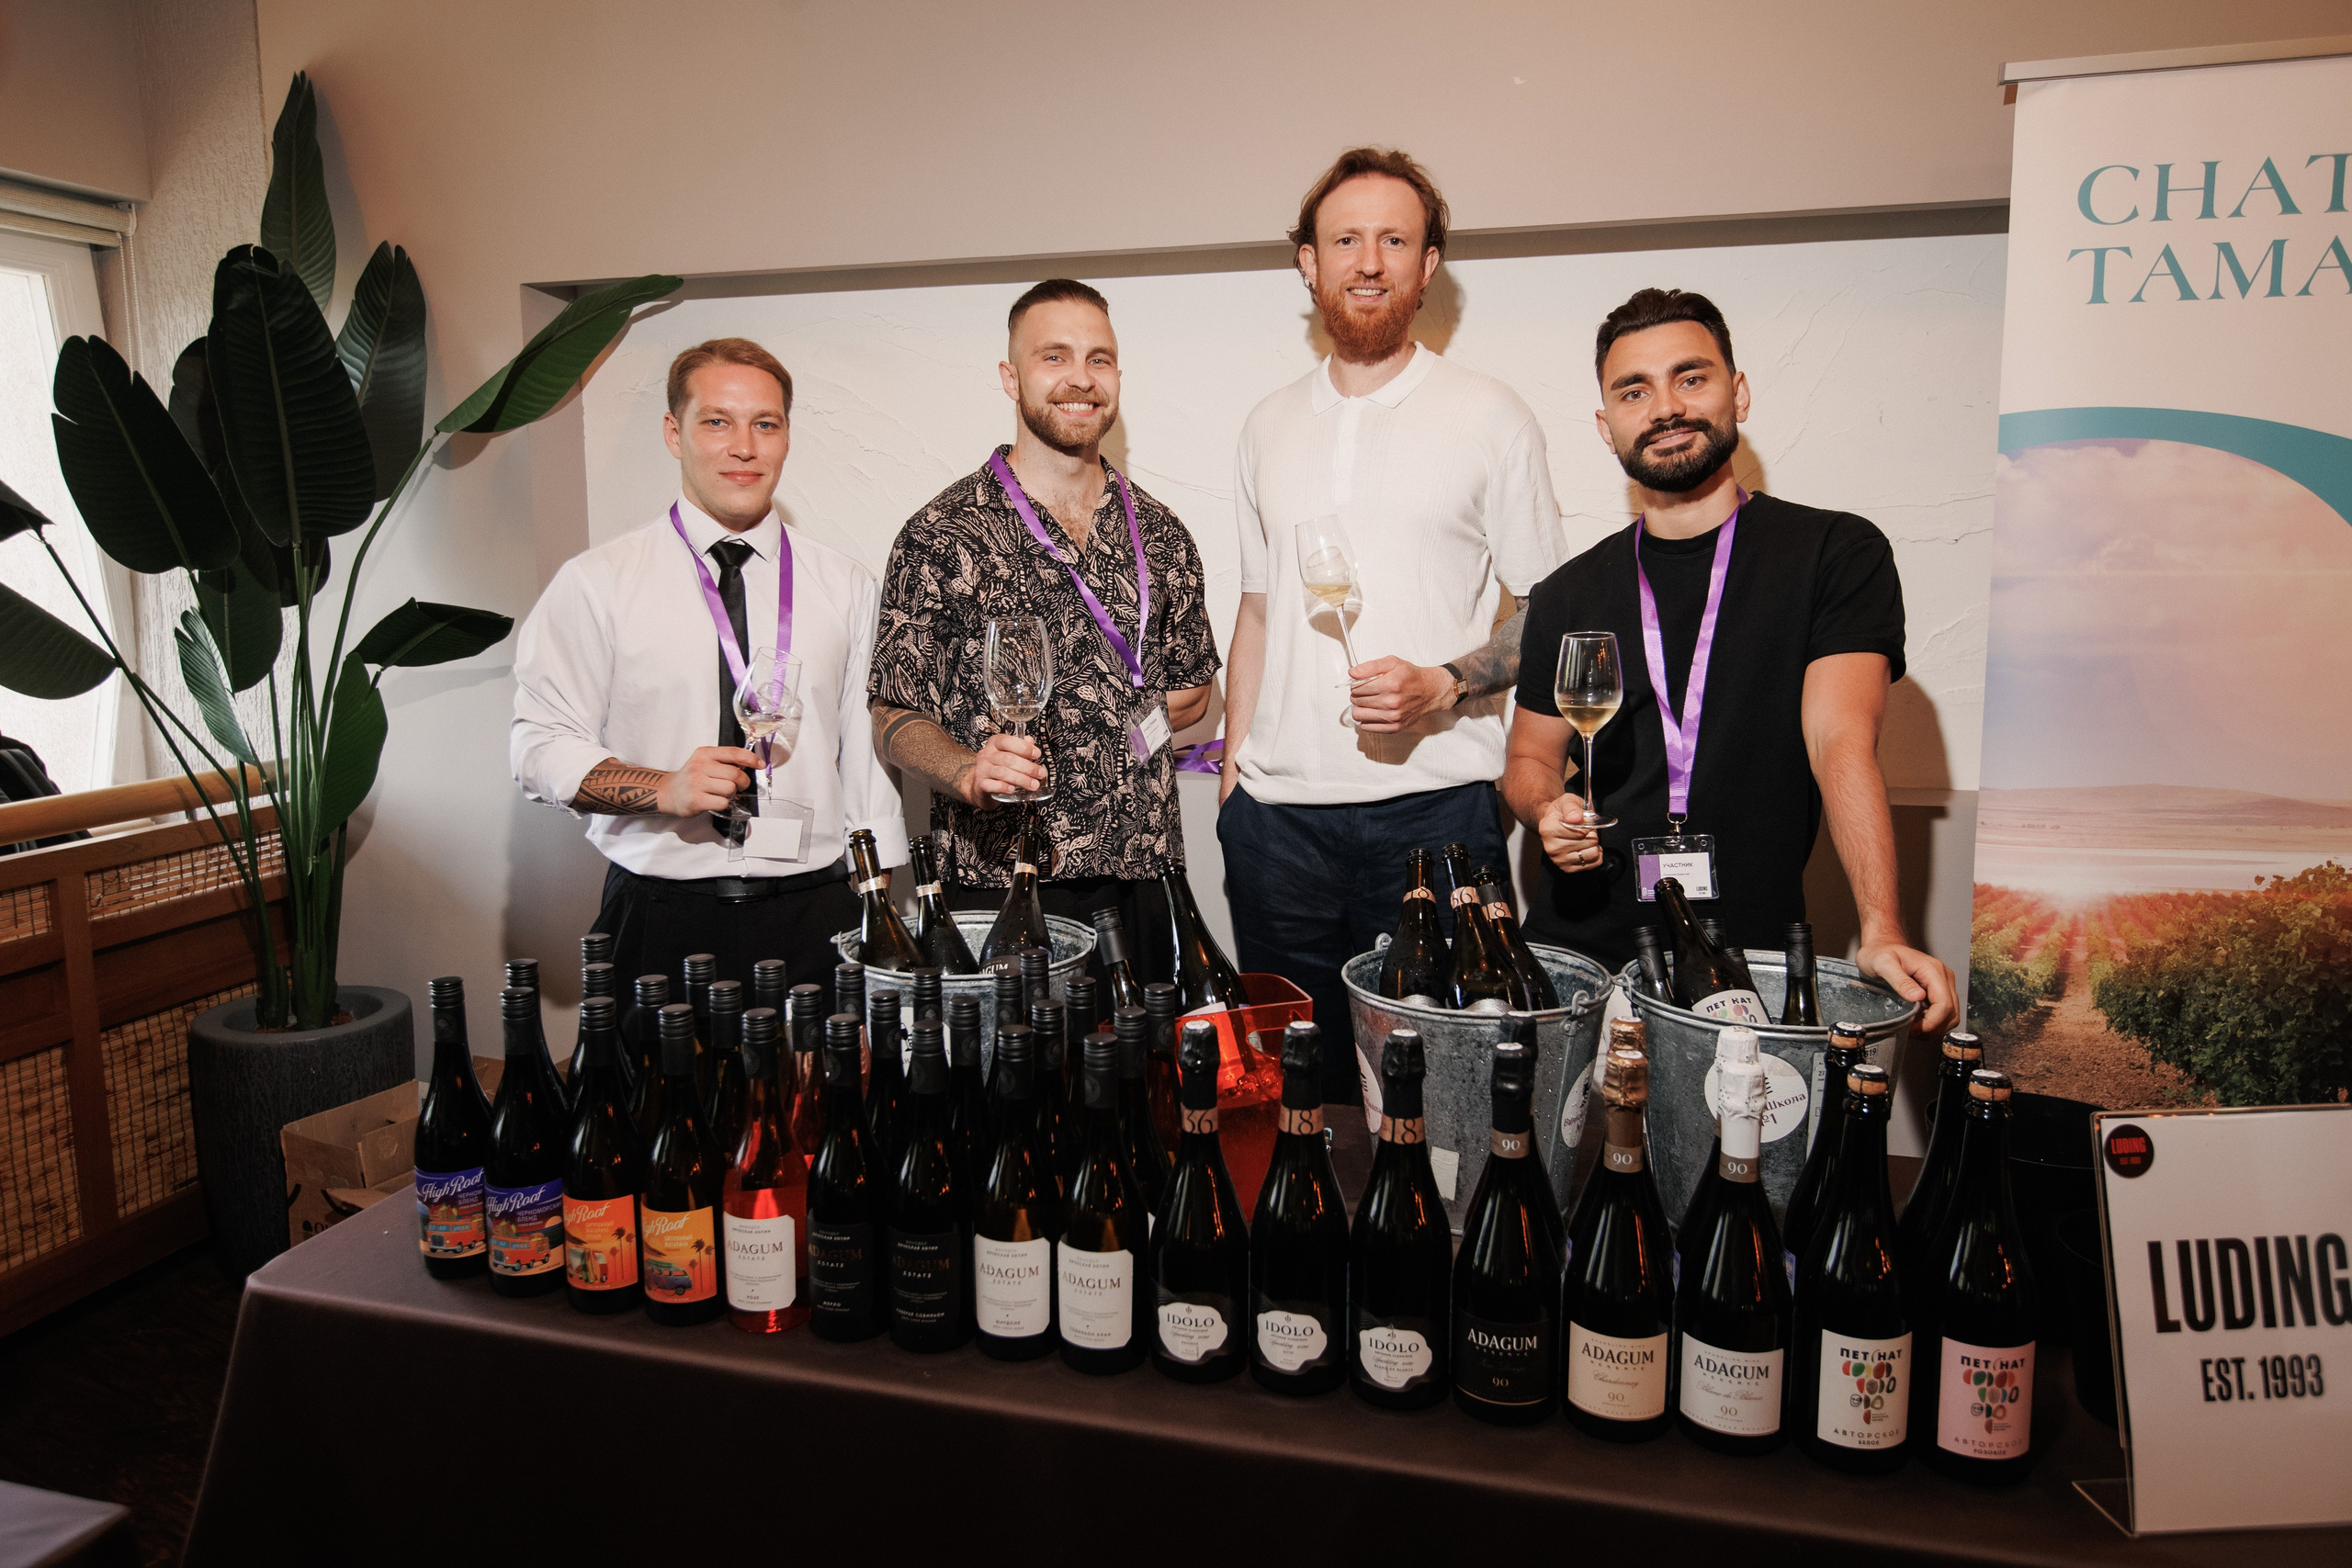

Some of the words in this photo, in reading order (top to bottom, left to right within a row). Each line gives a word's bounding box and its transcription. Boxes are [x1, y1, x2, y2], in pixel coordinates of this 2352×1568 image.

[2077, 152, 2352, 226] CHAT
[2066, 234, 2352, 305] TAMA
[1706, 999, 1725, 1012] ПЕТ
[1288, 1109, 1314, 1135] 18
[1391, 1118, 1417, 1145] 18
[1501, 1139, 1520, 1150] 90
[2111, 1136, 2146, 1154] LUDING
[1613, 1152, 1632, 1165] 90
[1727, 1161, 1747, 1174] 90
[423, 1181, 450, 1202] High
[450, 1168, 485, 1196] Roof
[459, 1196, 479, 1205] БЛЕНД
[487, 1196, 509, 1216] High
[509, 1185, 546, 1213] Roof
[576, 1201, 611, 1224] Roof
[656, 1213, 690, 1236] Roof
[728, 1240, 783, 1255] ADAGUM
[979, 1262, 1039, 1279] ADAGUM
[1062, 1271, 1121, 1290] ADAGUM
[2146, 1233, 2352, 1334] LUDING
[1167, 1313, 1215, 1326] IDOLO
[1266, 1320, 1314, 1336] IDOLO
[1369, 1337, 1419, 1352] IDOLO
[1468, 1328, 1538, 1350] ADAGUM
[1581, 1342, 1654, 1365] ADAGUM
[1839, 1348, 1869, 1361] ПЕТ
[1878, 1348, 1902, 1361] НАТ
[1590, 1359, 1645, 1371] RESERVE
[1694, 1354, 1770, 1380] ADAGUM
[1961, 1356, 1990, 1369] ПЕТ
[1999, 1358, 2025, 1370] НАТ
[1492, 1378, 1509, 1387] 90
[1593, 1370, 1639, 1389] Chardonnay
[1702, 1372, 1758, 1385] RESERVE
[2199, 1357, 2255, 1403] EST.
[2257, 1354, 2324, 1401] 1993
[1696, 1380, 1722, 1396] Blanc
[1608, 1391, 1624, 1402] 90
[1720, 1405, 1738, 1416] 90
[1834, 1427, 1900, 1438] АВТОРСКОЕ
[1953, 1437, 2023, 1449] АВТОРСКОЕ
